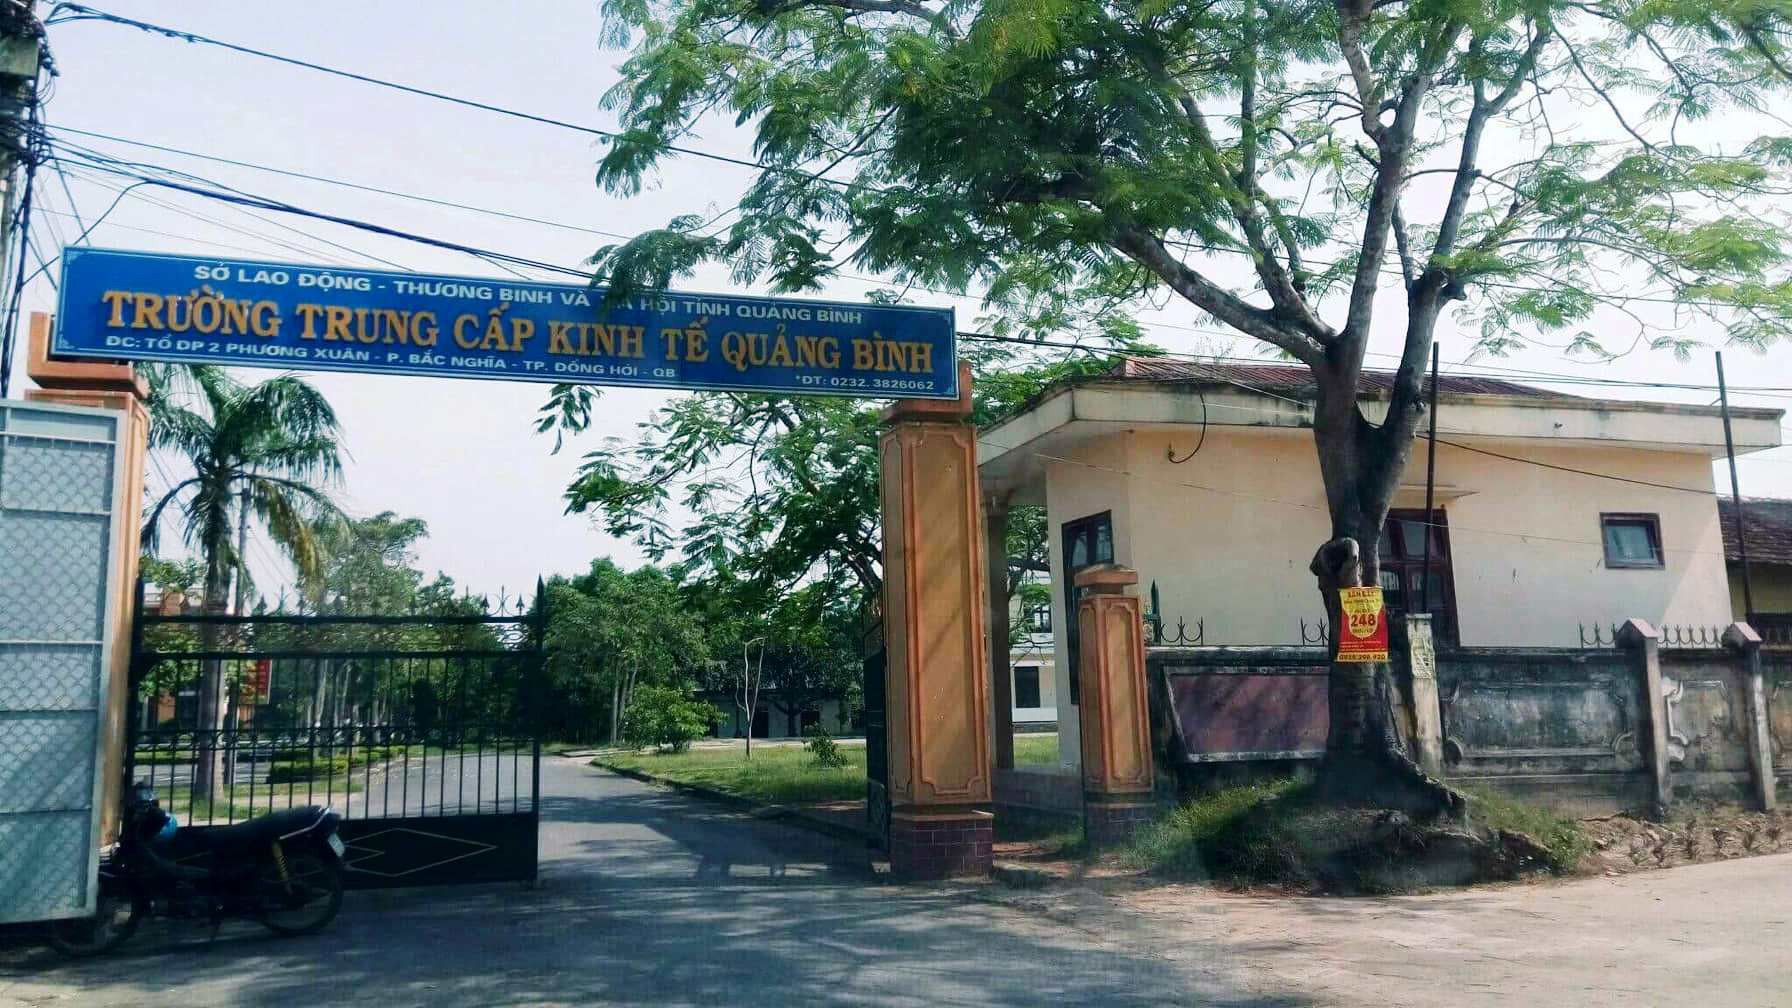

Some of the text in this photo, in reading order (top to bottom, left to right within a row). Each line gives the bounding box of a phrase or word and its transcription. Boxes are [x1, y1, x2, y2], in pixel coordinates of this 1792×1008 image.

[238, 269, 290, 286] LAO
[297, 272, 371, 292] ĐỘNG
[393, 280, 492, 300] THƯƠNG
[499, 288, 552, 304] BINH
[560, 289, 591, 307] VÀ
[816, 307, 862, 325] BÌNH
[102, 284, 934, 374] TRƯỜNG TRUNG CẤP KINH TẾ QUẢNG BÌNH
[207, 342, 220, 353] 2
[451, 354, 507, 369] NGHĨA
[653, 367, 676, 379] QB
[1350, 613, 1376, 627] 248
